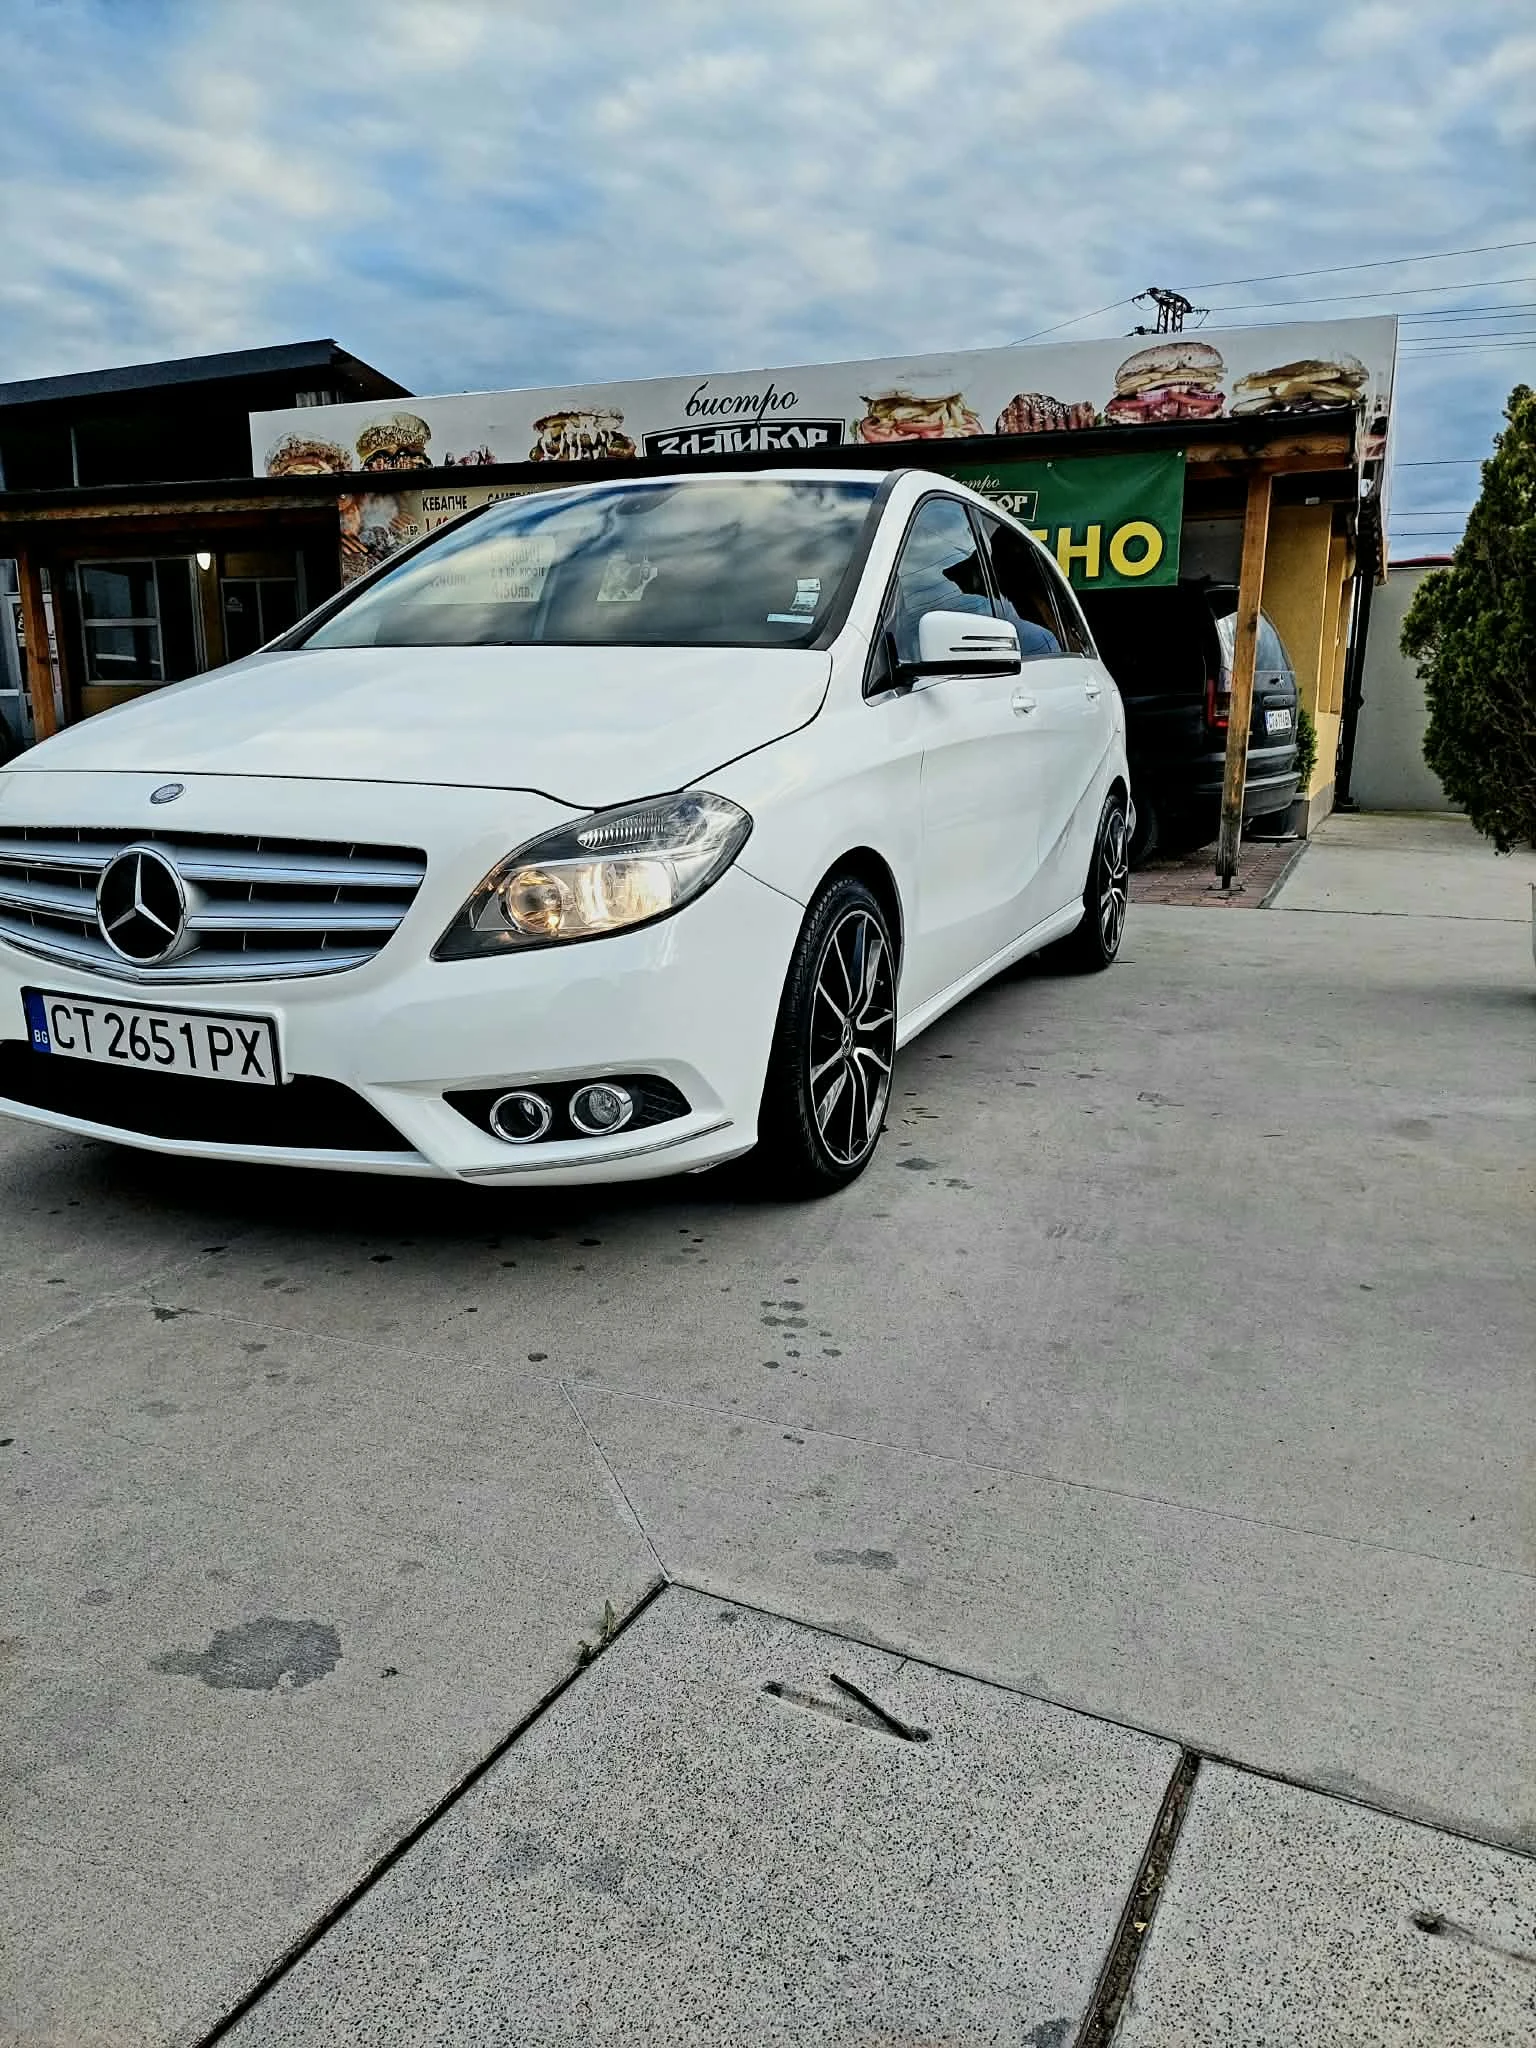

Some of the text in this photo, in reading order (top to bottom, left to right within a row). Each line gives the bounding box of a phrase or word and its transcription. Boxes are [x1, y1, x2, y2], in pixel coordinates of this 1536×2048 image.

[685, 381, 799, 421] бистро
[422, 495, 468, 512] КЕБАПЧЕ
[34, 1029, 48, 1044] BG
[51, 1004, 267, 1078] CT 2651 PX
